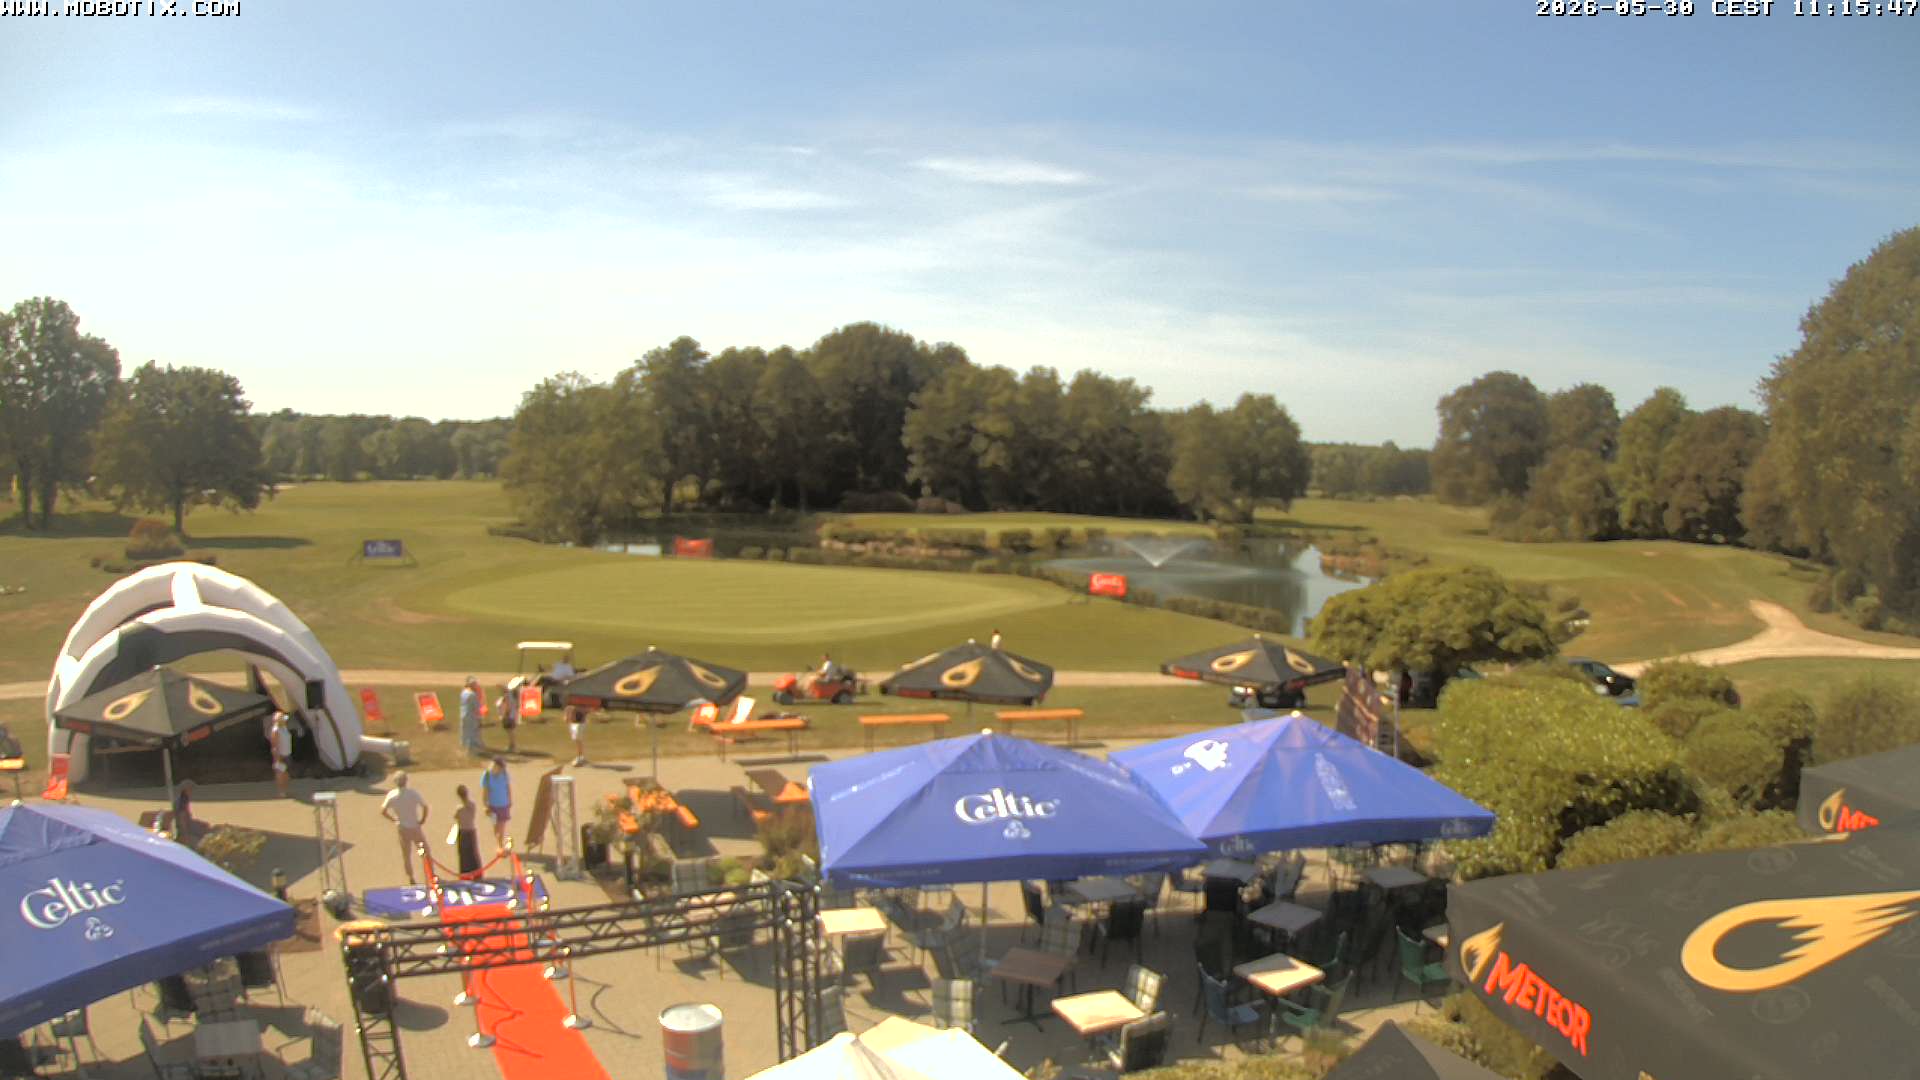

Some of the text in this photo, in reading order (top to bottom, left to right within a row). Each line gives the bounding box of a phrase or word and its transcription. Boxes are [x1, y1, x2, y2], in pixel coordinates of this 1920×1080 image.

[955, 787, 1056, 824] Celtic
[20, 877, 127, 929] Celtic
[1484, 951, 1592, 1057] METEOR
